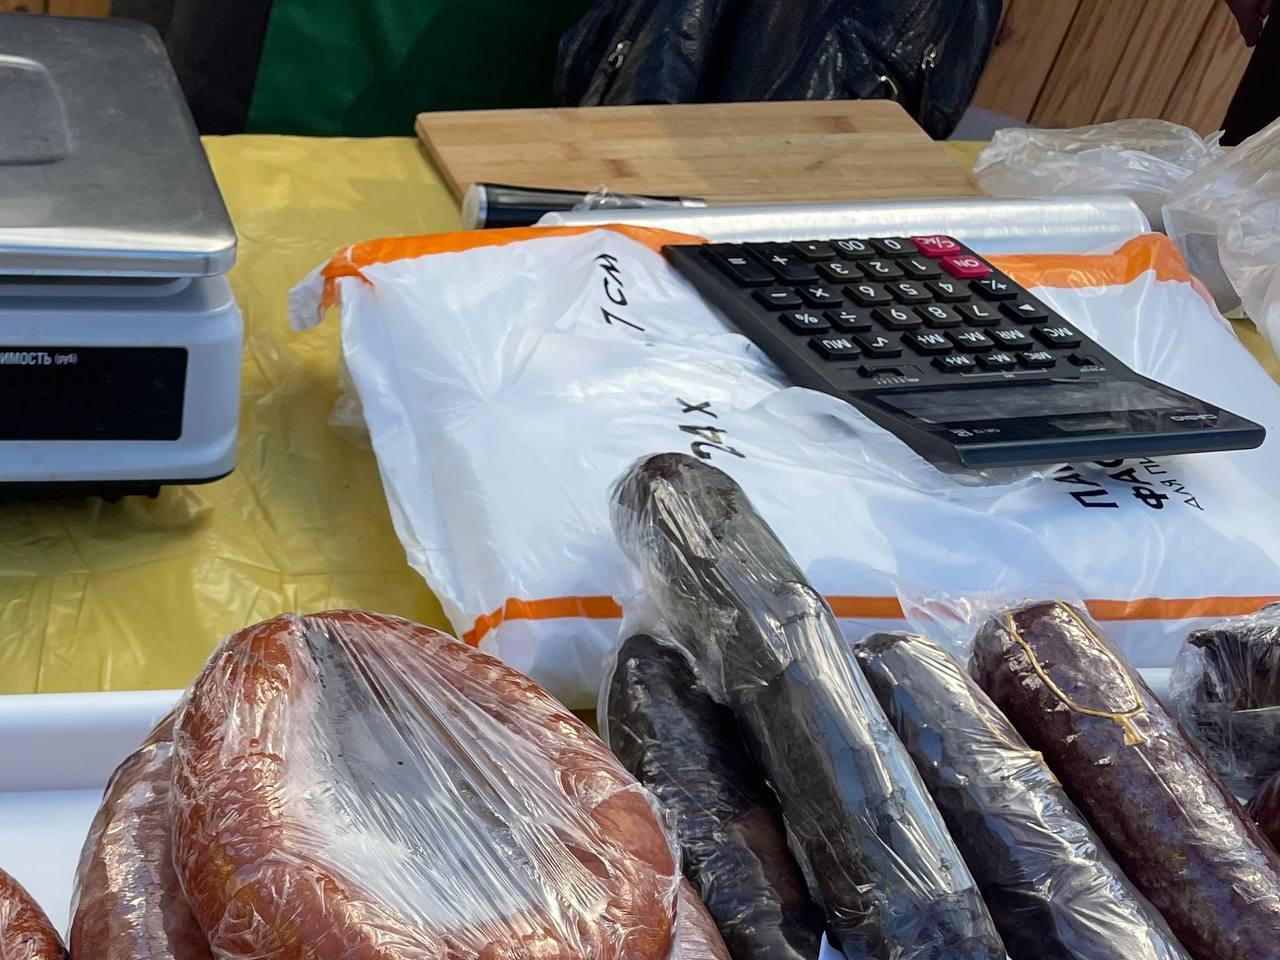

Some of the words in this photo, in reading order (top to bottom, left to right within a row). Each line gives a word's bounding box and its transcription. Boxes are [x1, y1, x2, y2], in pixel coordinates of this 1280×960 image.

[837, 239, 865, 251] 00
[830, 263, 849, 275] 3
[869, 261, 889, 273] 2
[911, 260, 927, 272] 1
[953, 258, 980, 269] ON
[858, 285, 875, 297] 6
[898, 284, 918, 296] 5
[938, 282, 954, 293] 4
[891, 308, 907, 320] 9
[928, 306, 947, 318] 8
[972, 304, 989, 316] 7
